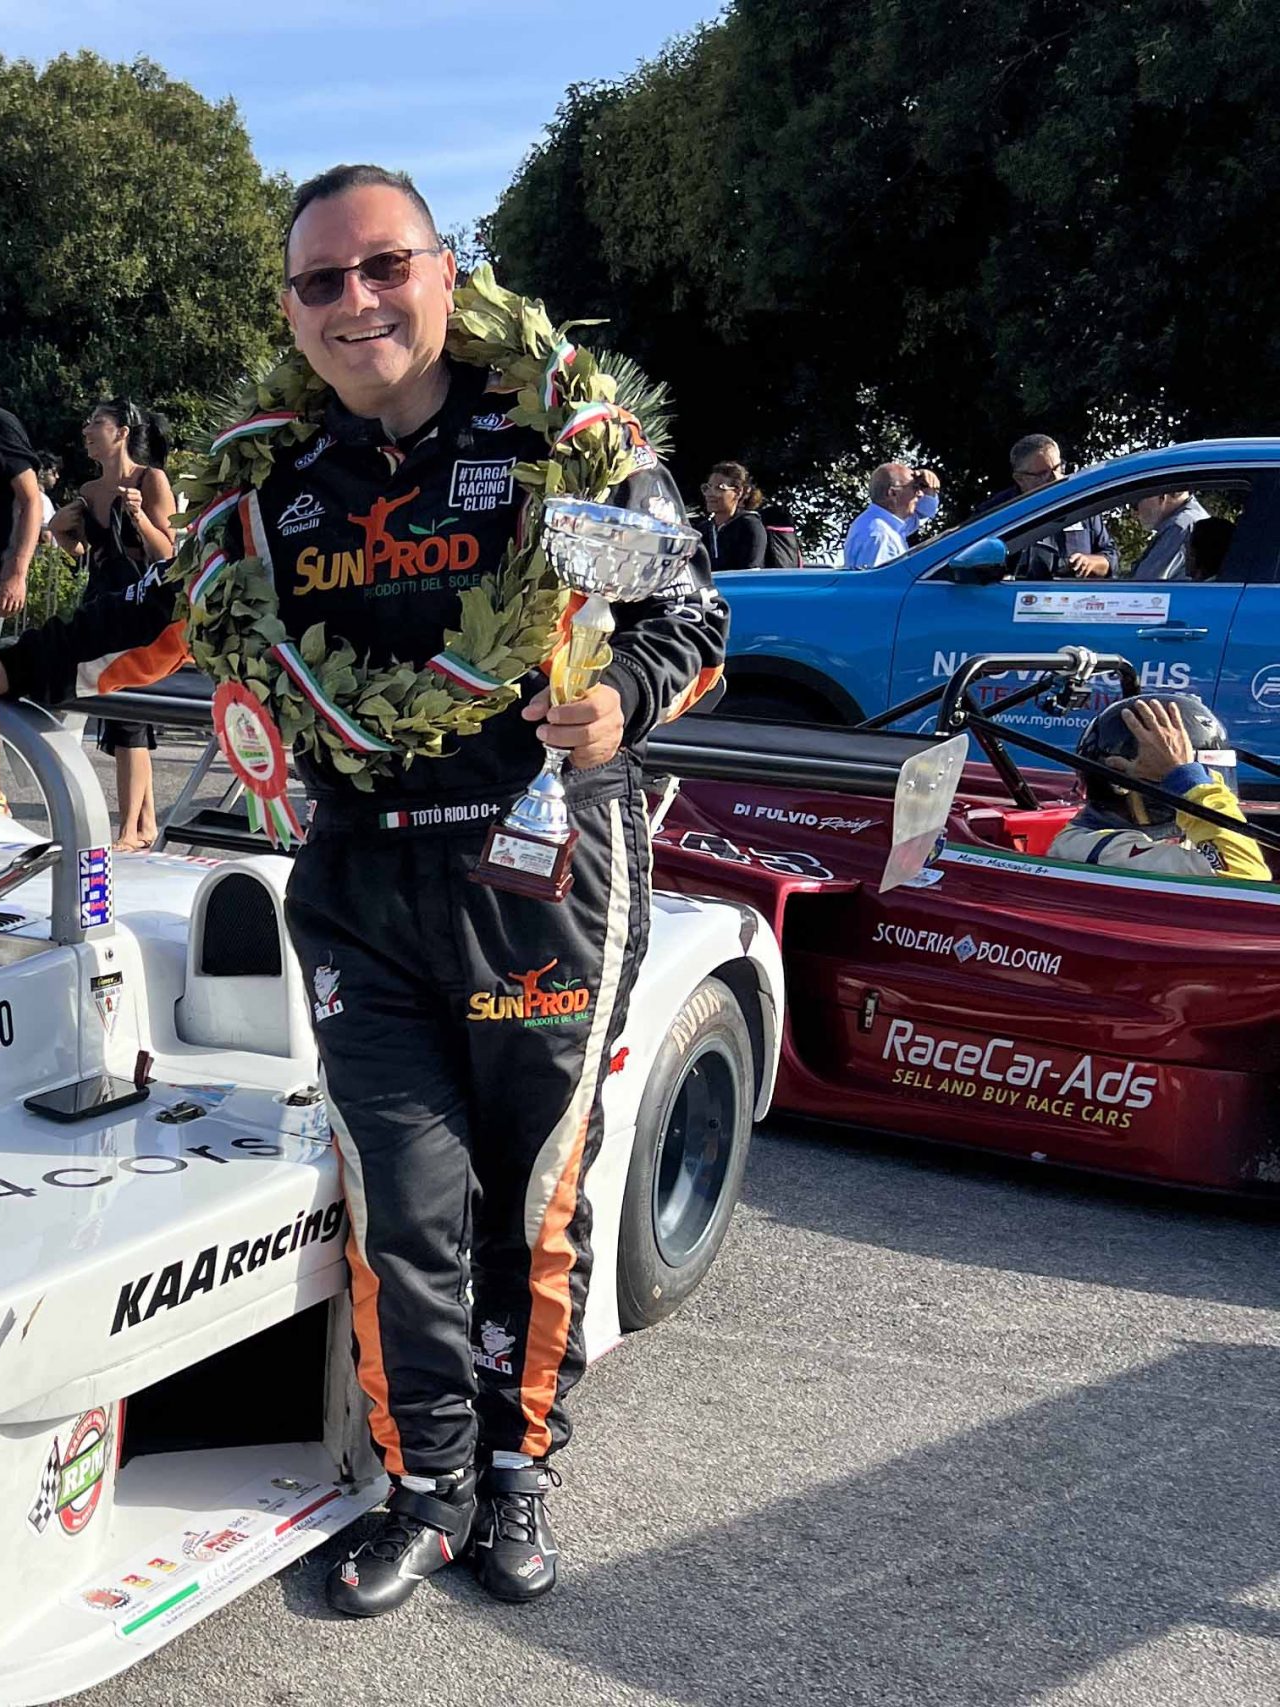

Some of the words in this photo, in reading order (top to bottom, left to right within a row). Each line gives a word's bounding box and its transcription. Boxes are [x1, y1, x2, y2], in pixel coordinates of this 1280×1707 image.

[459, 465, 508, 481] #TARGA
[458, 480, 505, 496] RACING
[463, 496, 497, 511] CLUB
[421, 576, 442, 590] DEL
[448, 574, 482, 588] SOLE
[991, 713, 1090, 729] www.mgmoto
[410, 804, 441, 826] TOTÒ
[444, 804, 479, 823] RIOLO
[733, 803, 750, 816] DI
[754, 806, 818, 826] FULVIO
[872, 923, 954, 955] SCUDERIA
[976, 942, 1062, 975] BOLOGNA
[671, 988, 722, 1056] AVON
[882, 1018, 1158, 1109] RaceCar-Ads
[891, 1068, 933, 1090] SELL
[937, 1077, 977, 1098] AND
[982, 1087, 1021, 1107] BUY
[1025, 1095, 1075, 1118] RACE
[1081, 1106, 1133, 1129] CARS
[109, 1244, 219, 1337] KAA
[219, 1198, 347, 1287] Racing
